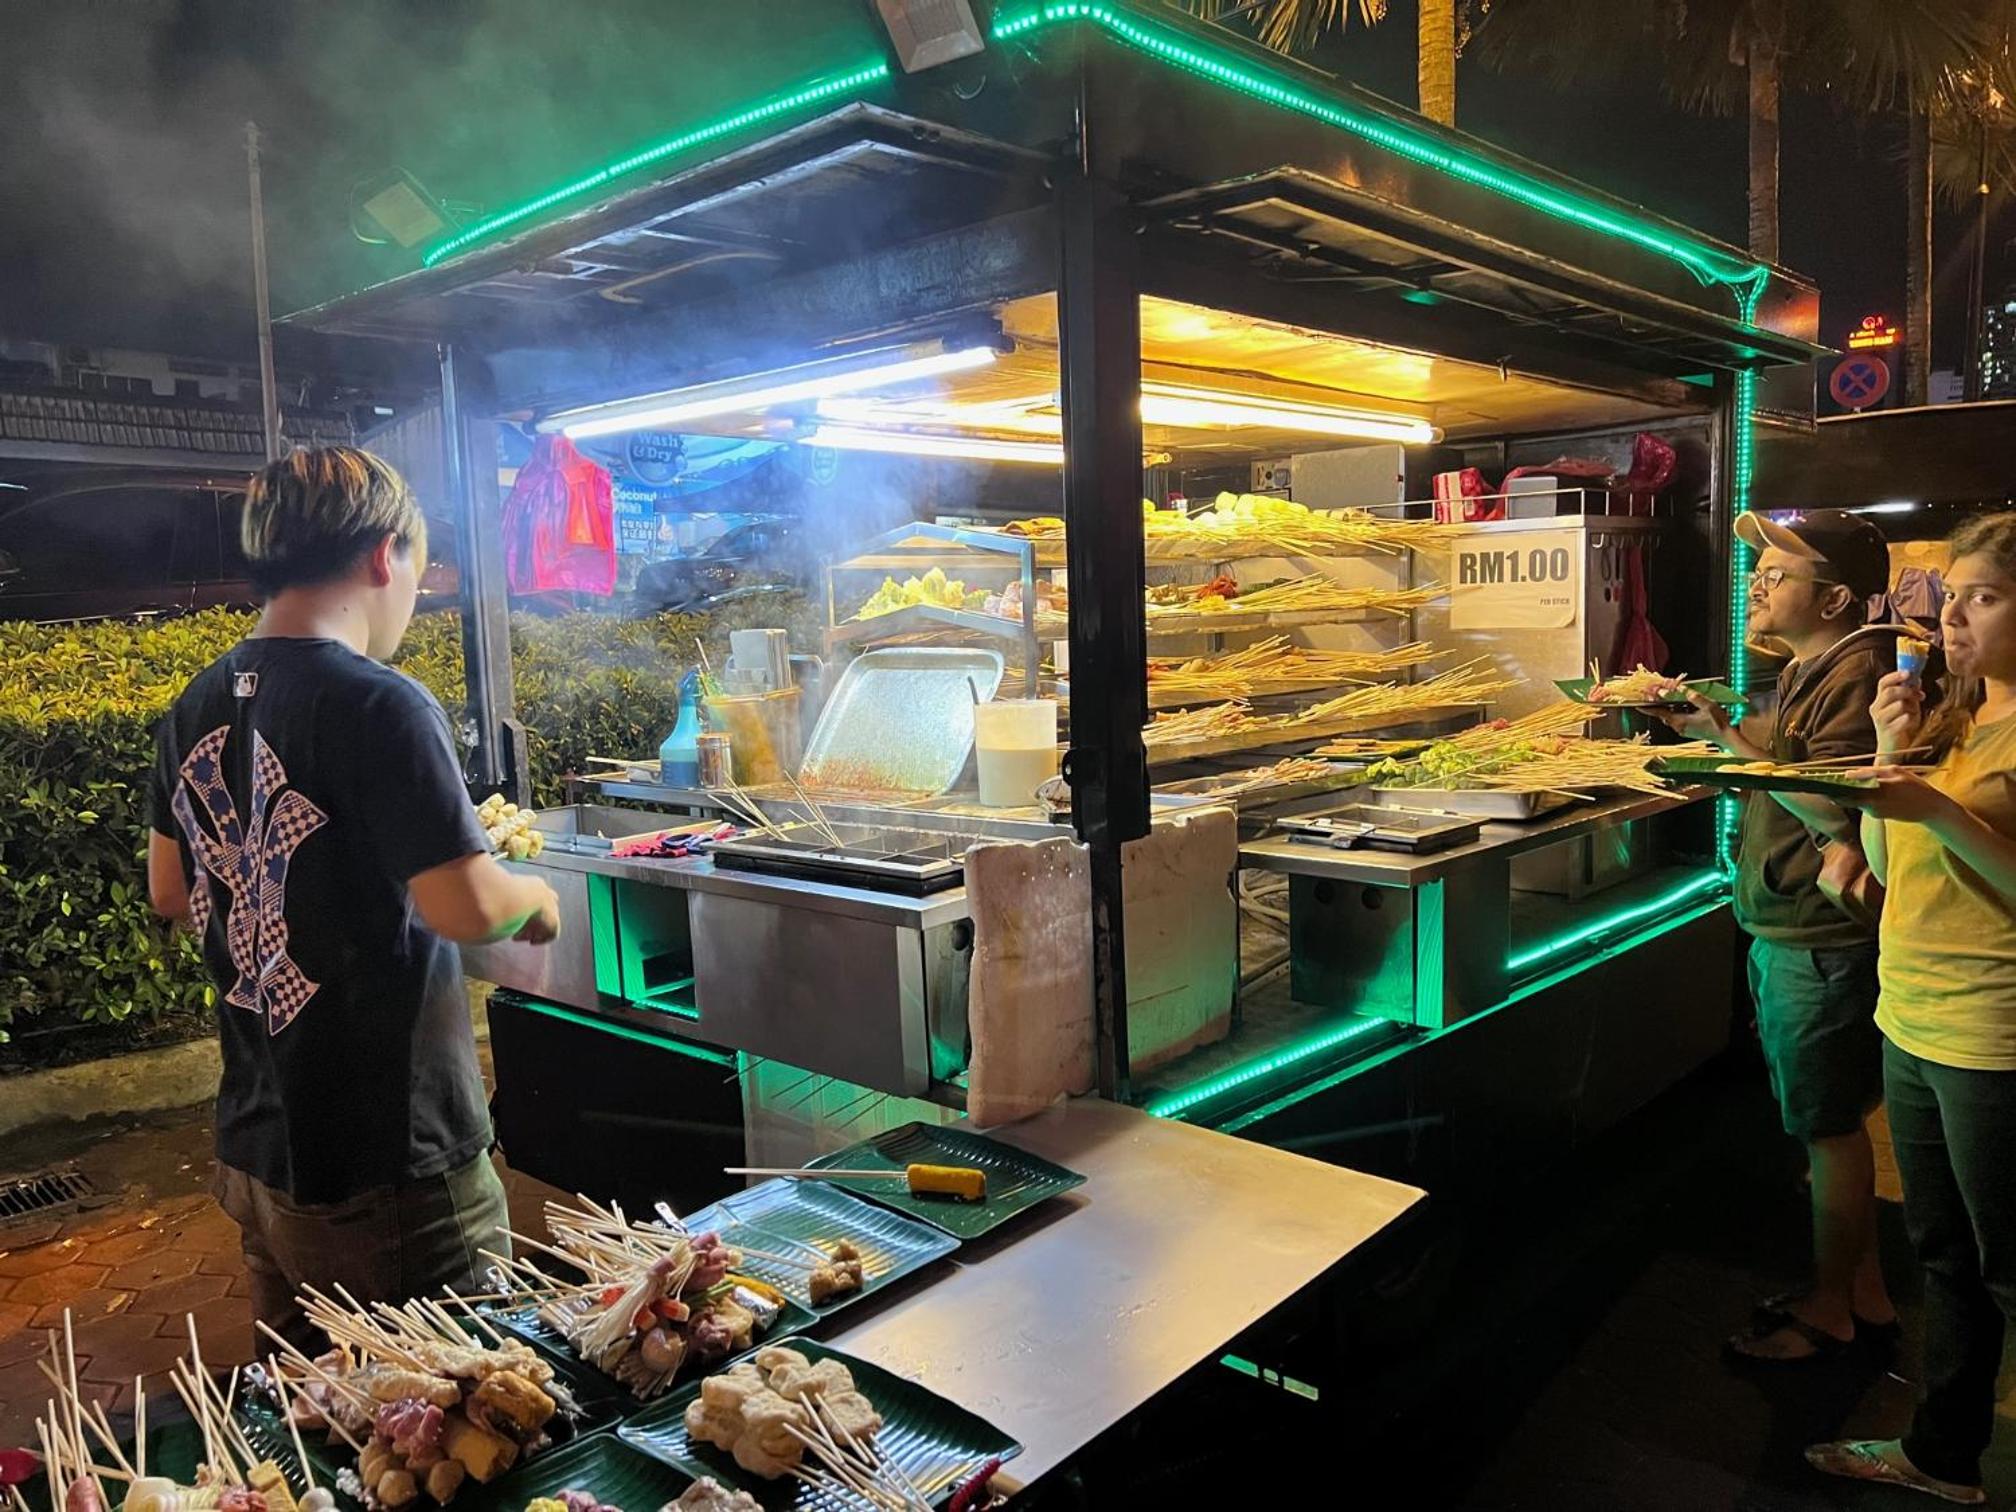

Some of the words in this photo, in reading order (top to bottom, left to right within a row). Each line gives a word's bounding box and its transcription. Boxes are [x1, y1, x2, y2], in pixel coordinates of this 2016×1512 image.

[639, 432, 678, 447] Wash
[648, 447, 672, 462] Dry
[611, 487, 657, 501] Coconut
[1459, 548, 1569, 584] RM1.00
